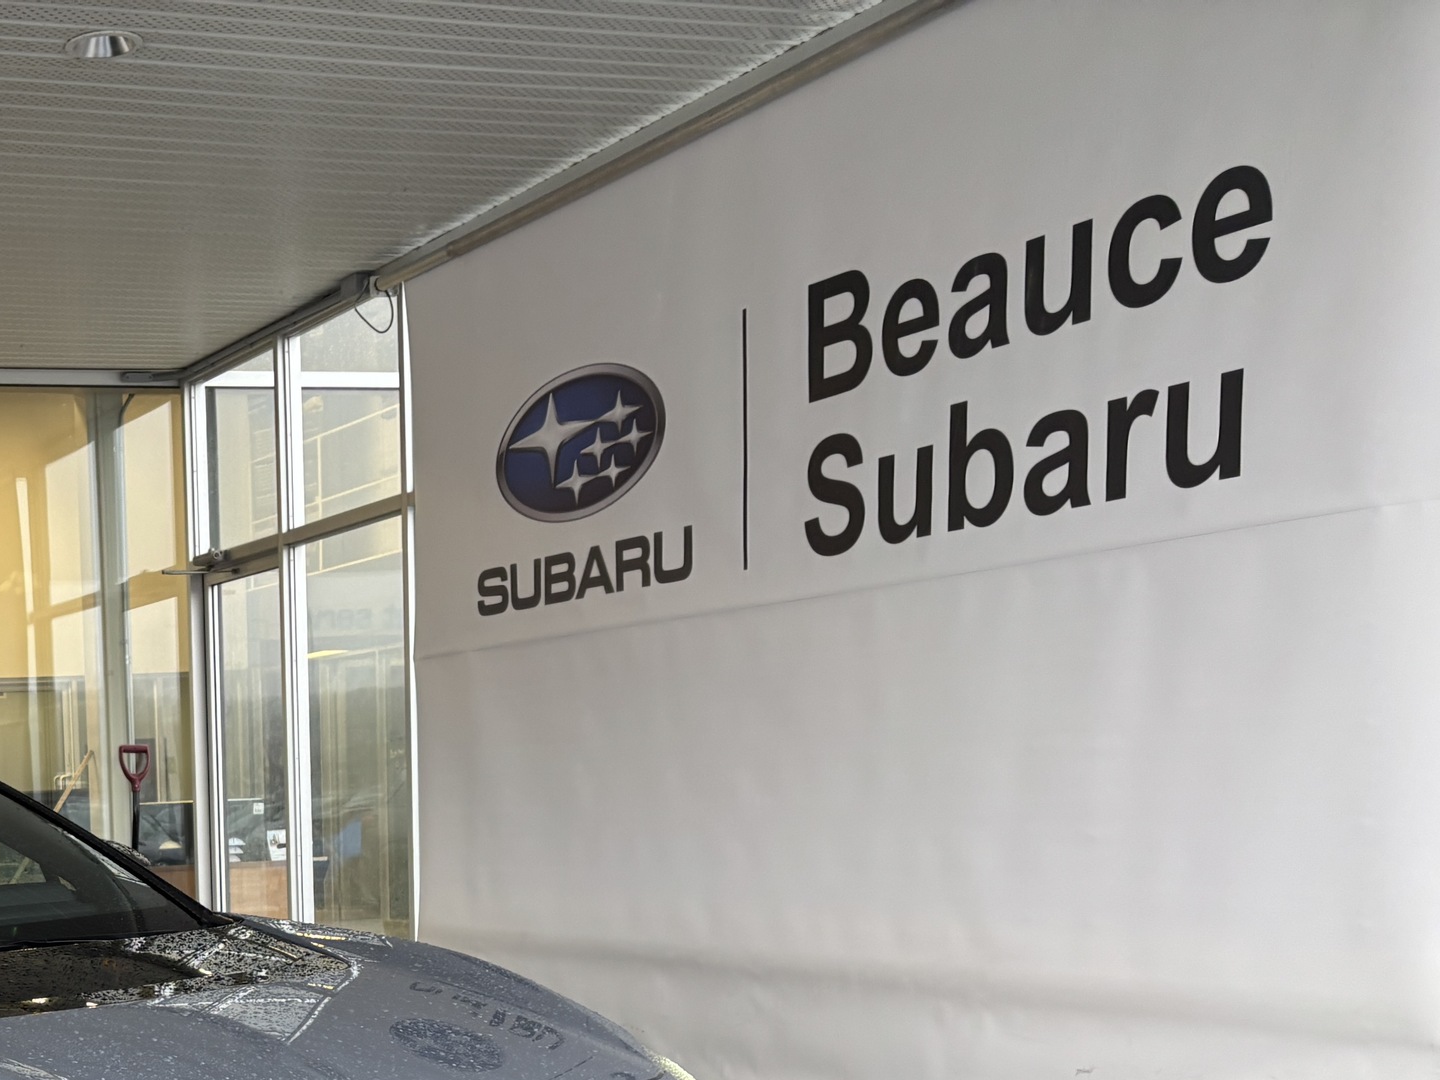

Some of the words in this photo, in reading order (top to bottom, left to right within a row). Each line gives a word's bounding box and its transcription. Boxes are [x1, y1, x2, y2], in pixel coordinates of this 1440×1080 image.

[808, 165, 1274, 403] Beauce
[804, 368, 1245, 556] Subaru
[476, 525, 693, 616] SUBARU
